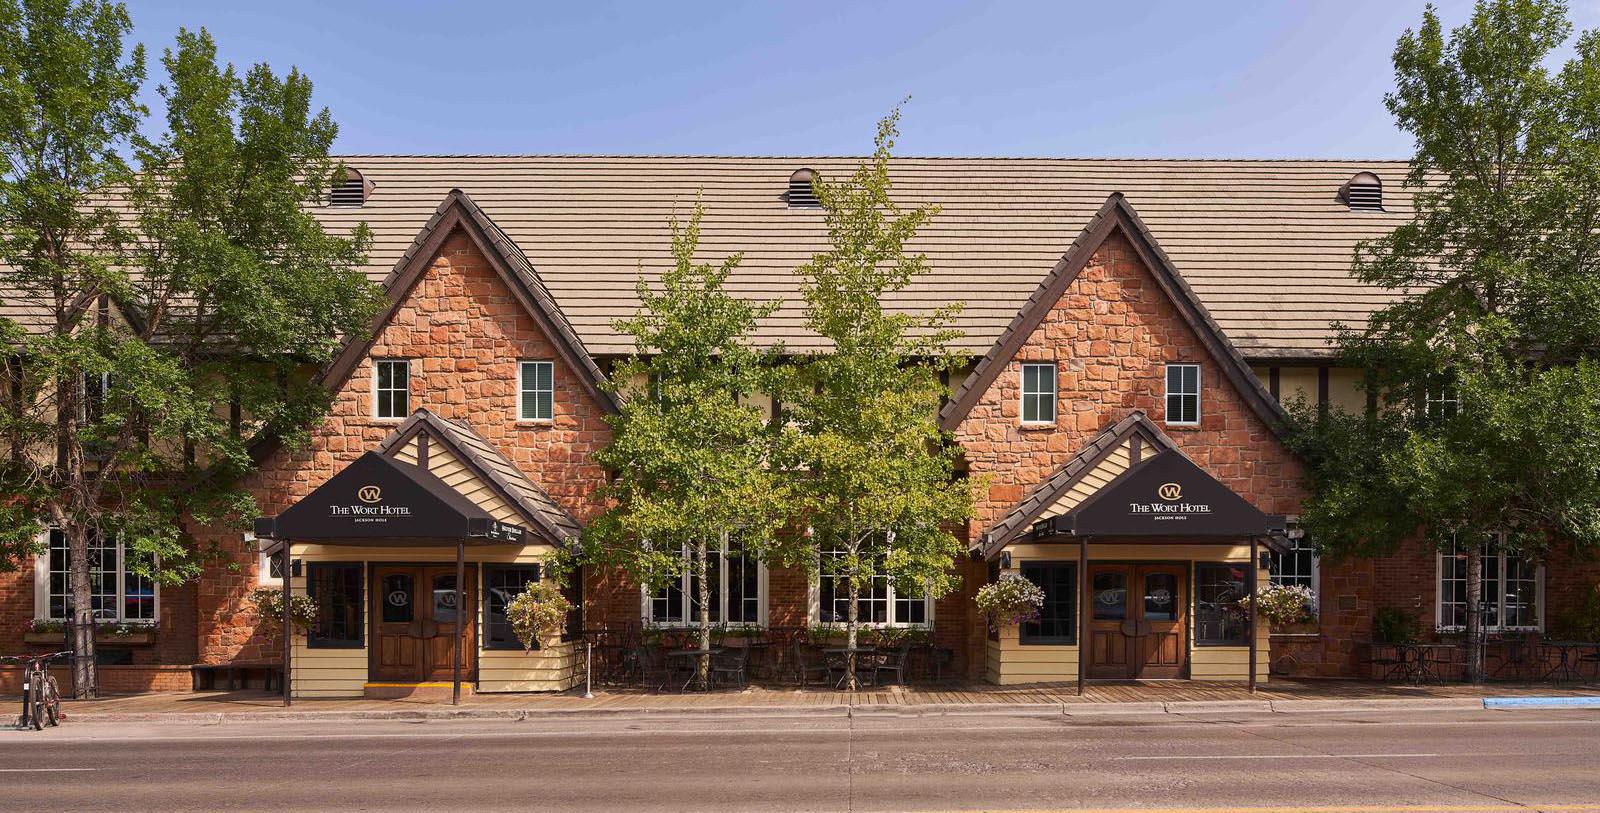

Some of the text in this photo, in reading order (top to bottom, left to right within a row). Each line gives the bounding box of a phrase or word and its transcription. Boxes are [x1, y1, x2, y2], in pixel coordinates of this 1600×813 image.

[330, 506, 410, 514] THE WORT HOTEL
[1130, 504, 1210, 512] THE WORT HOTEL
